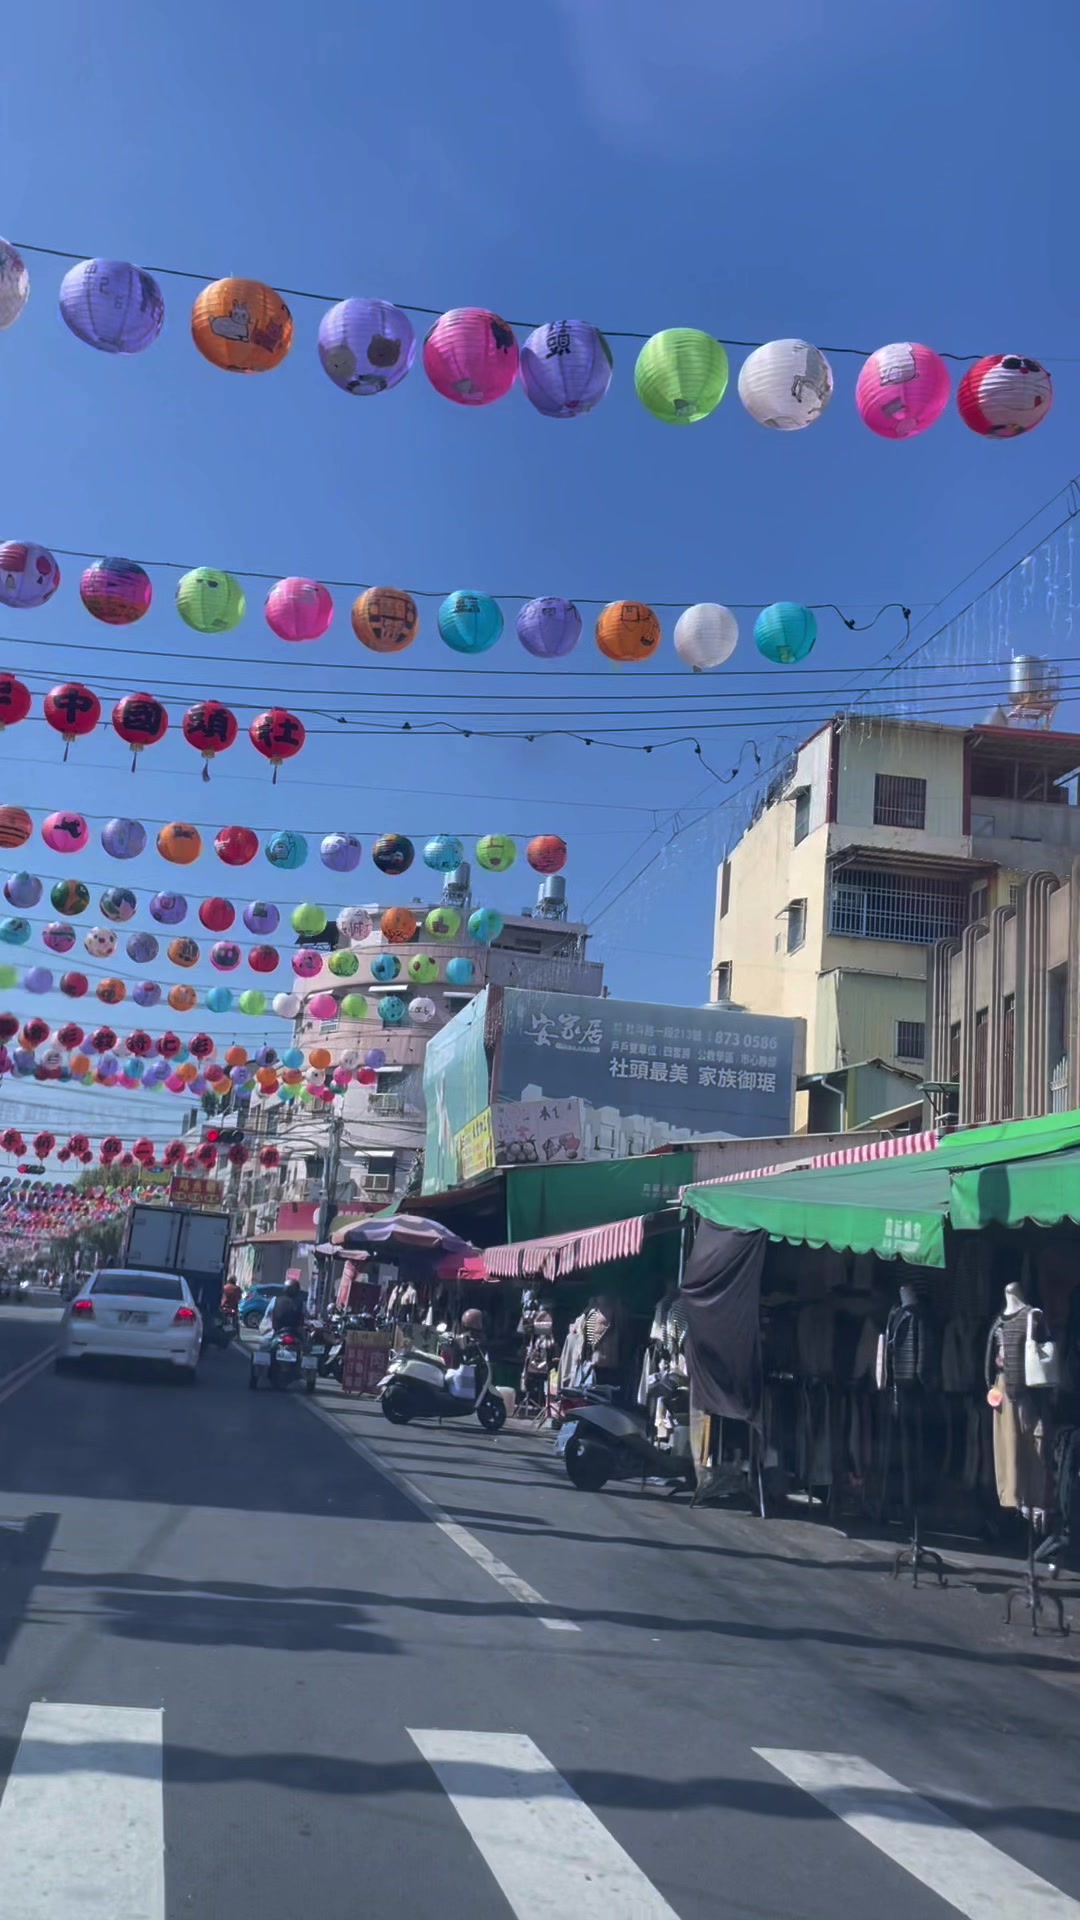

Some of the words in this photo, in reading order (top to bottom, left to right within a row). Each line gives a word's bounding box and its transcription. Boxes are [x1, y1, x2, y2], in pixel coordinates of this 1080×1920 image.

[53, 688, 93, 724] 中
[123, 700, 162, 735] 國
[187, 706, 228, 742] 頭
[715, 1031, 740, 1047] 873
[609, 1056, 689, 1085] 社頭最美
